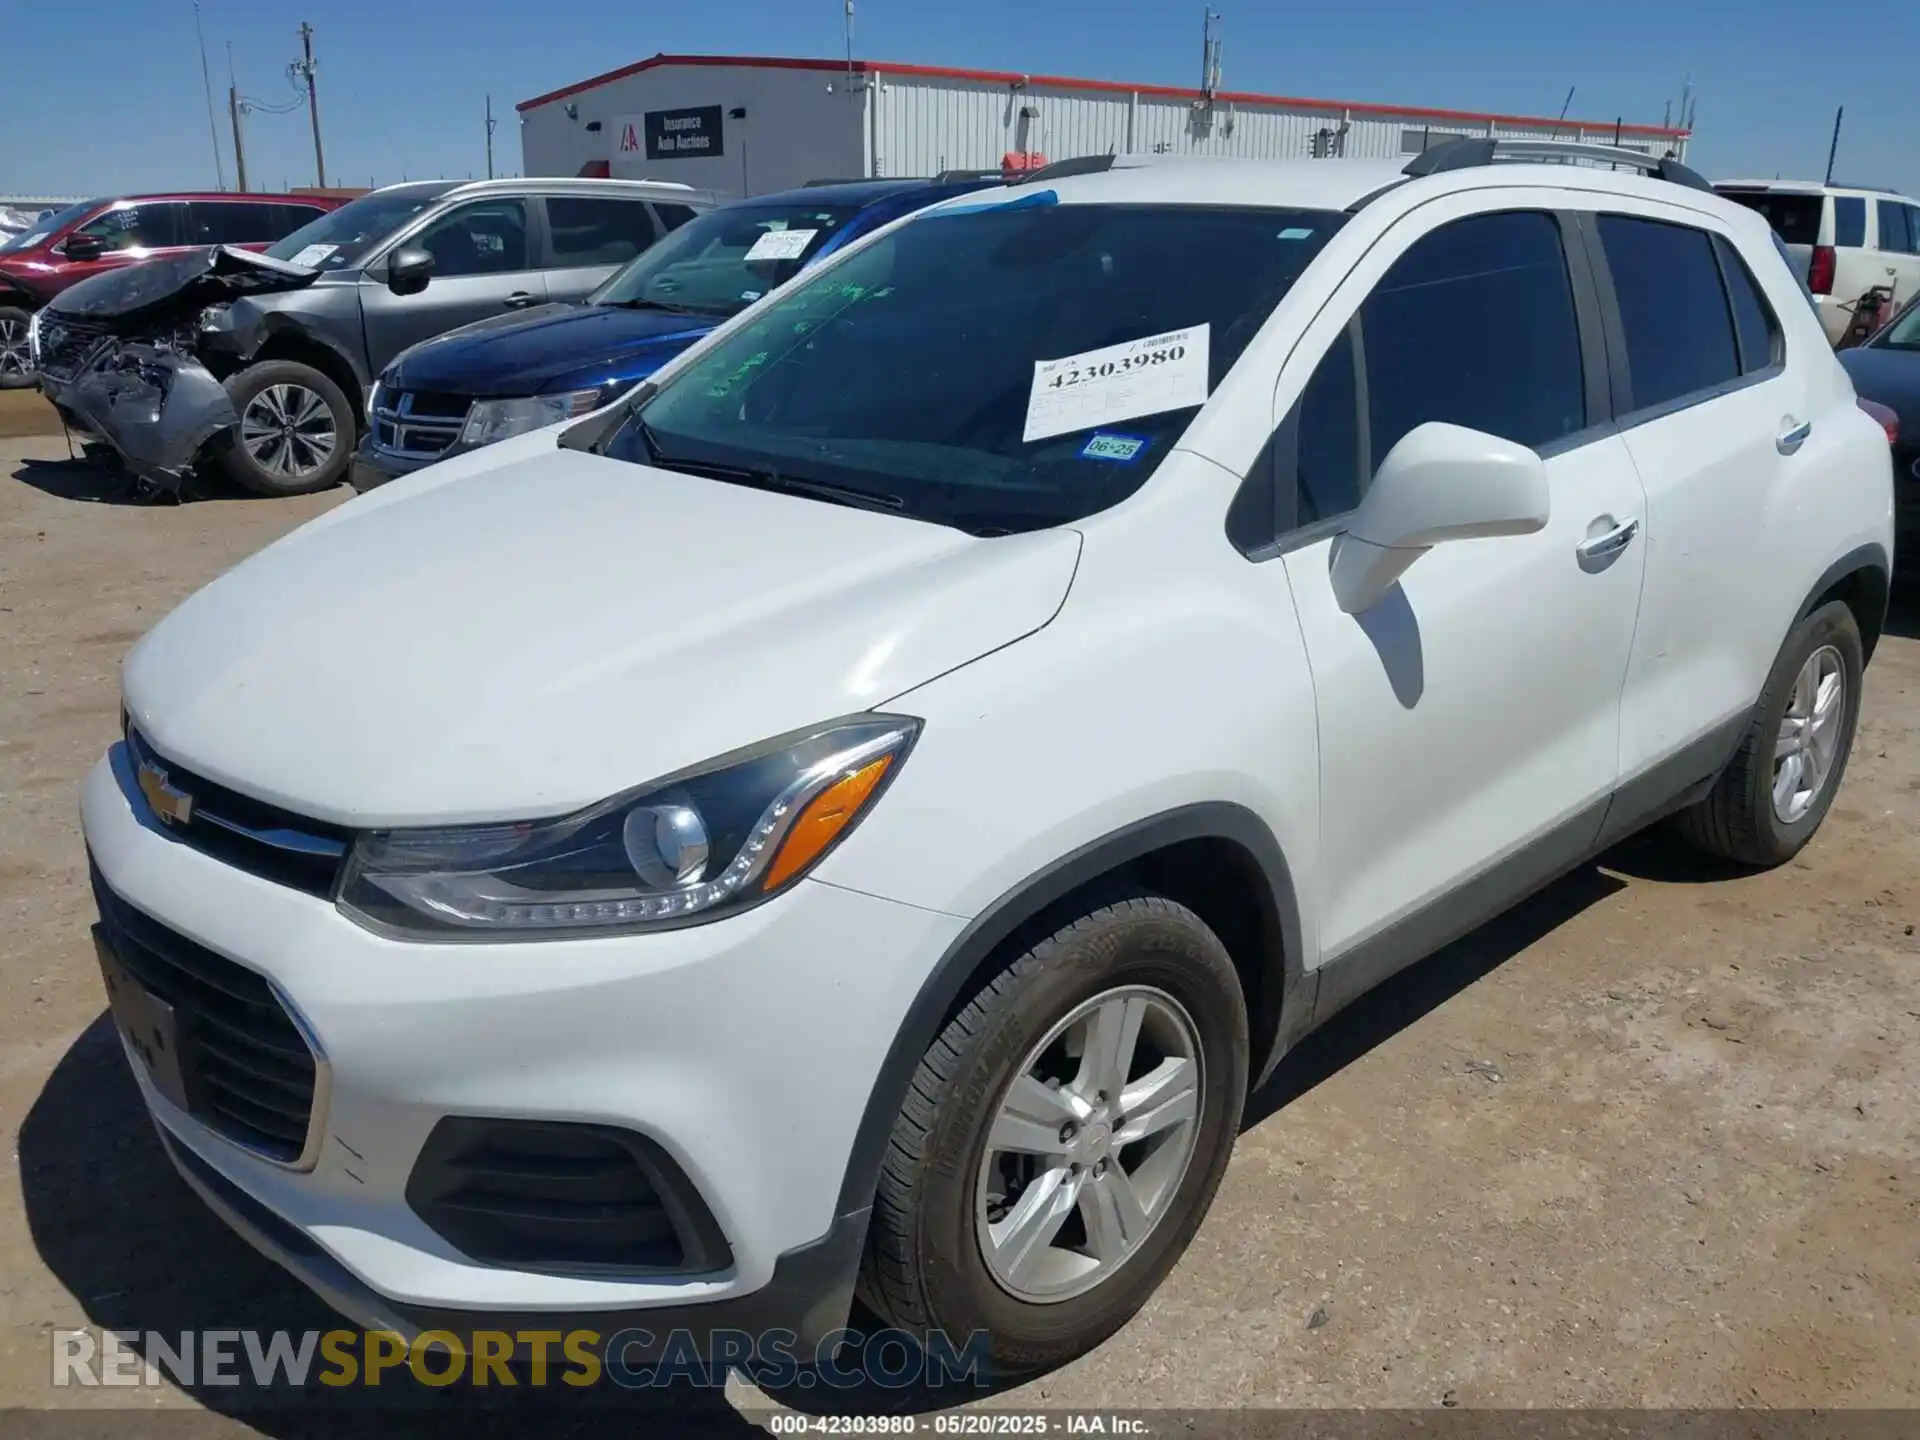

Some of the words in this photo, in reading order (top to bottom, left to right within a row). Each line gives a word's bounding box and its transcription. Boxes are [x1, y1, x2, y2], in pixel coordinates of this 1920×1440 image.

[664, 116, 701, 131] Insurance
[677, 134, 711, 150] Auctions
[1048, 346, 1185, 388] 42303980
